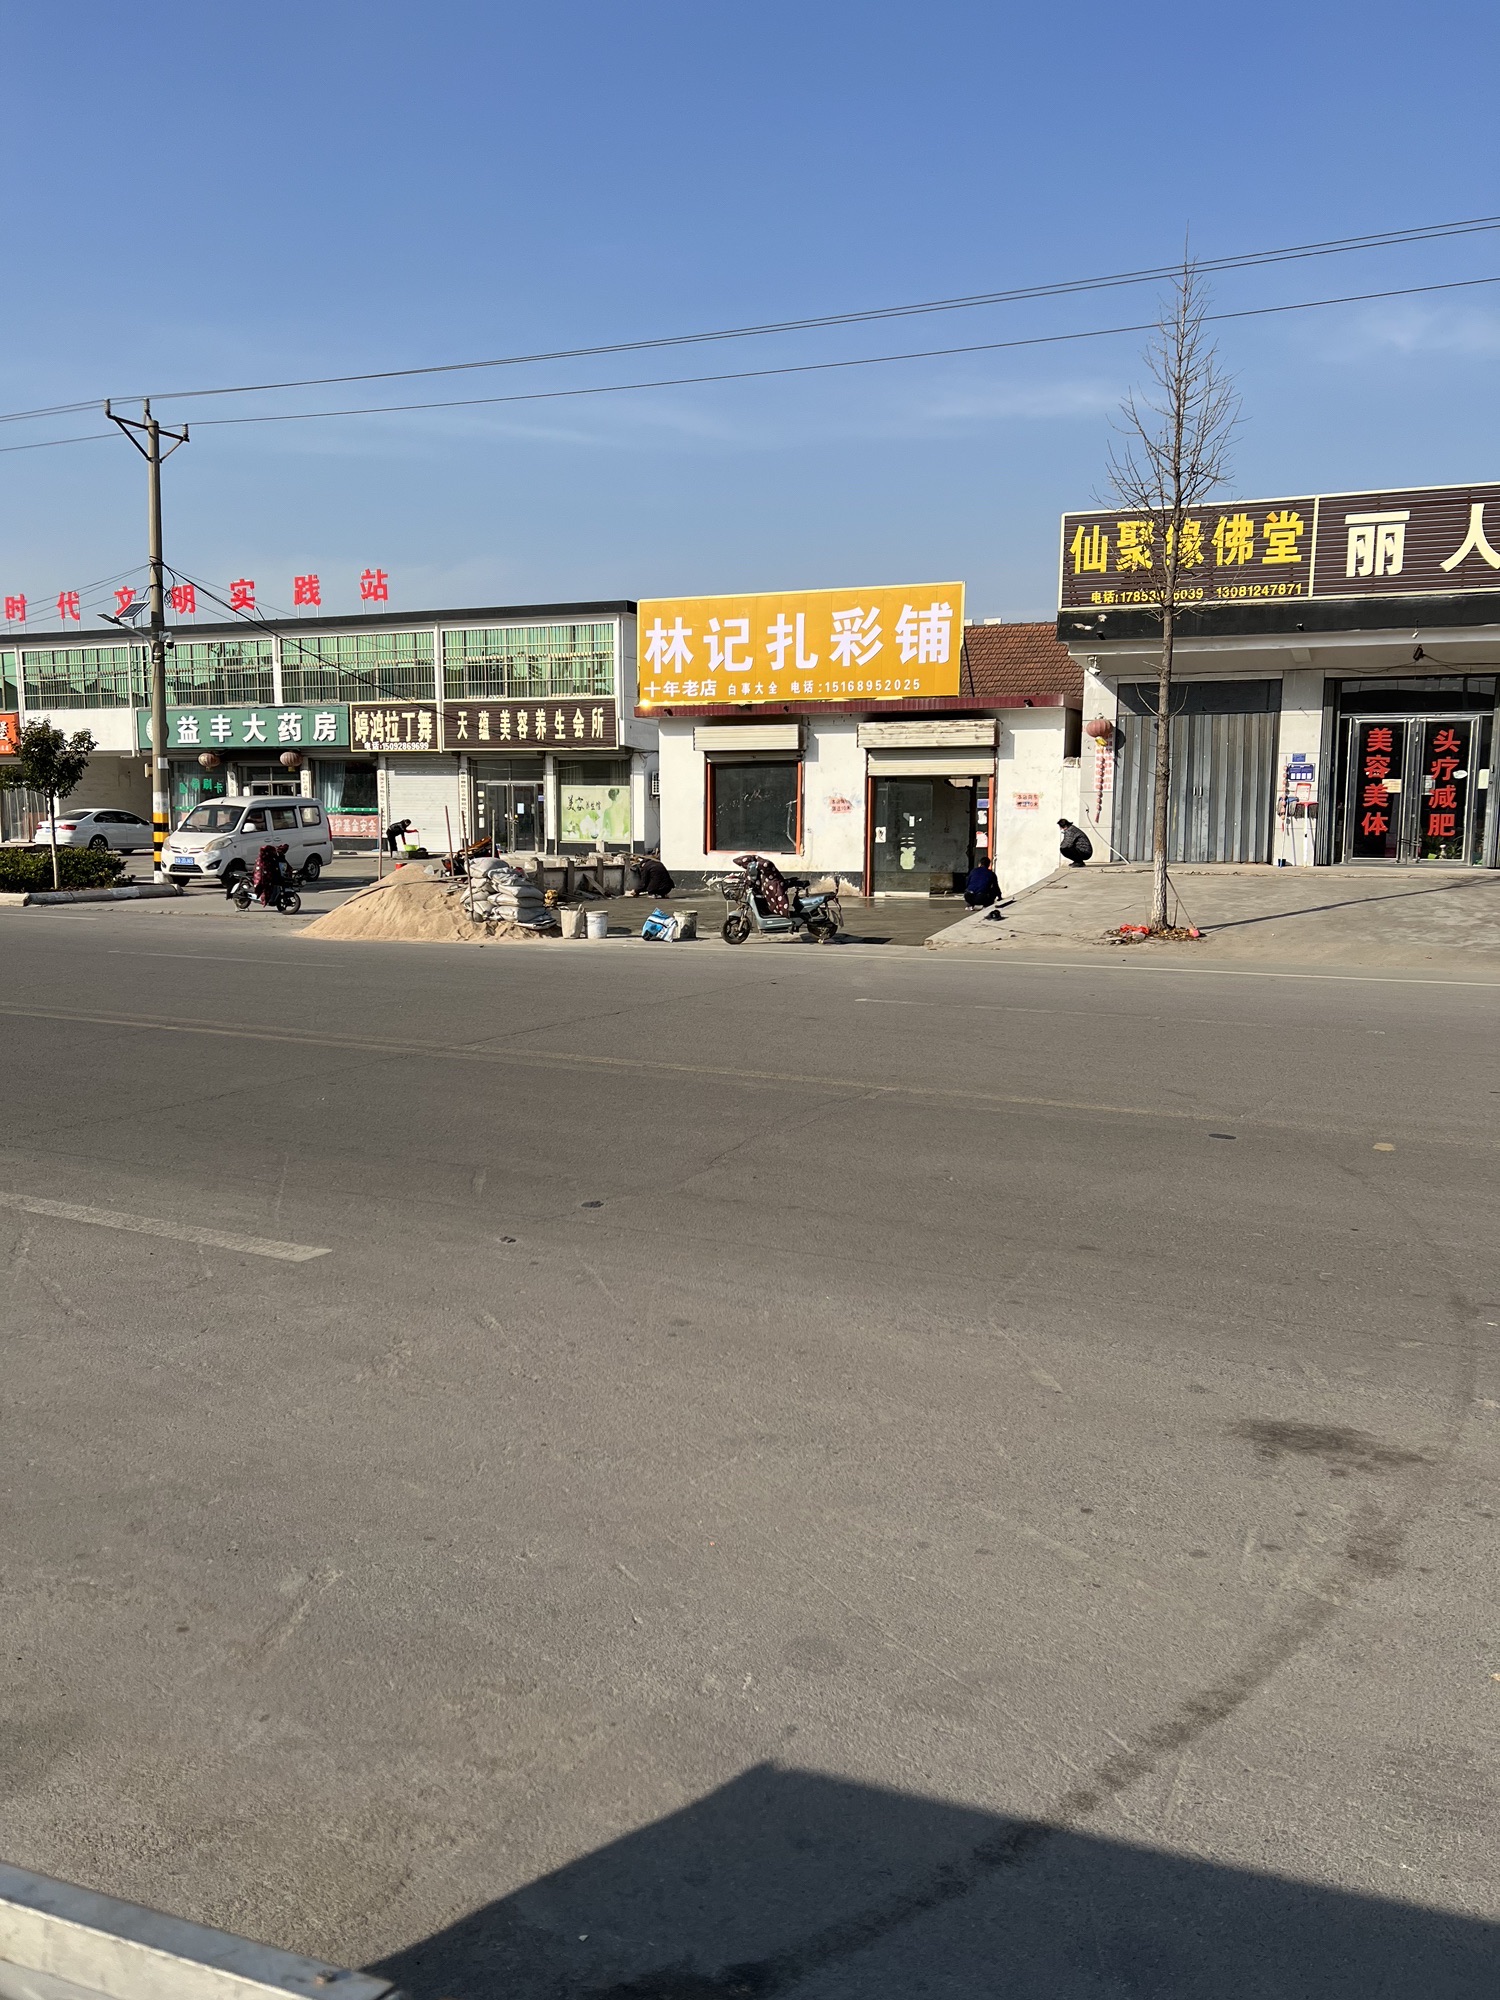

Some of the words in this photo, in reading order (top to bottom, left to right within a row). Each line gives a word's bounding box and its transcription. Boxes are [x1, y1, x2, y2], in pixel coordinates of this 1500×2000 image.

[1069, 510, 1304, 575] 仙聚缘佛堂
[1345, 503, 1500, 577] 丽人
[4, 568, 389, 622] 时代文明实践站
[1216, 583, 1302, 598] 13081247871
[643, 601, 953, 674] 林记扎彩铺
[643, 679, 718, 698] 十年老店
[728, 682, 778, 696] 白事大全
[177, 711, 338, 744] 益丰大药房
[354, 709, 433, 743] 婷鸿拉丁舞
[1361, 727, 1393, 836] 美容美体
[1427, 728, 1461, 837] 头疗减肥
